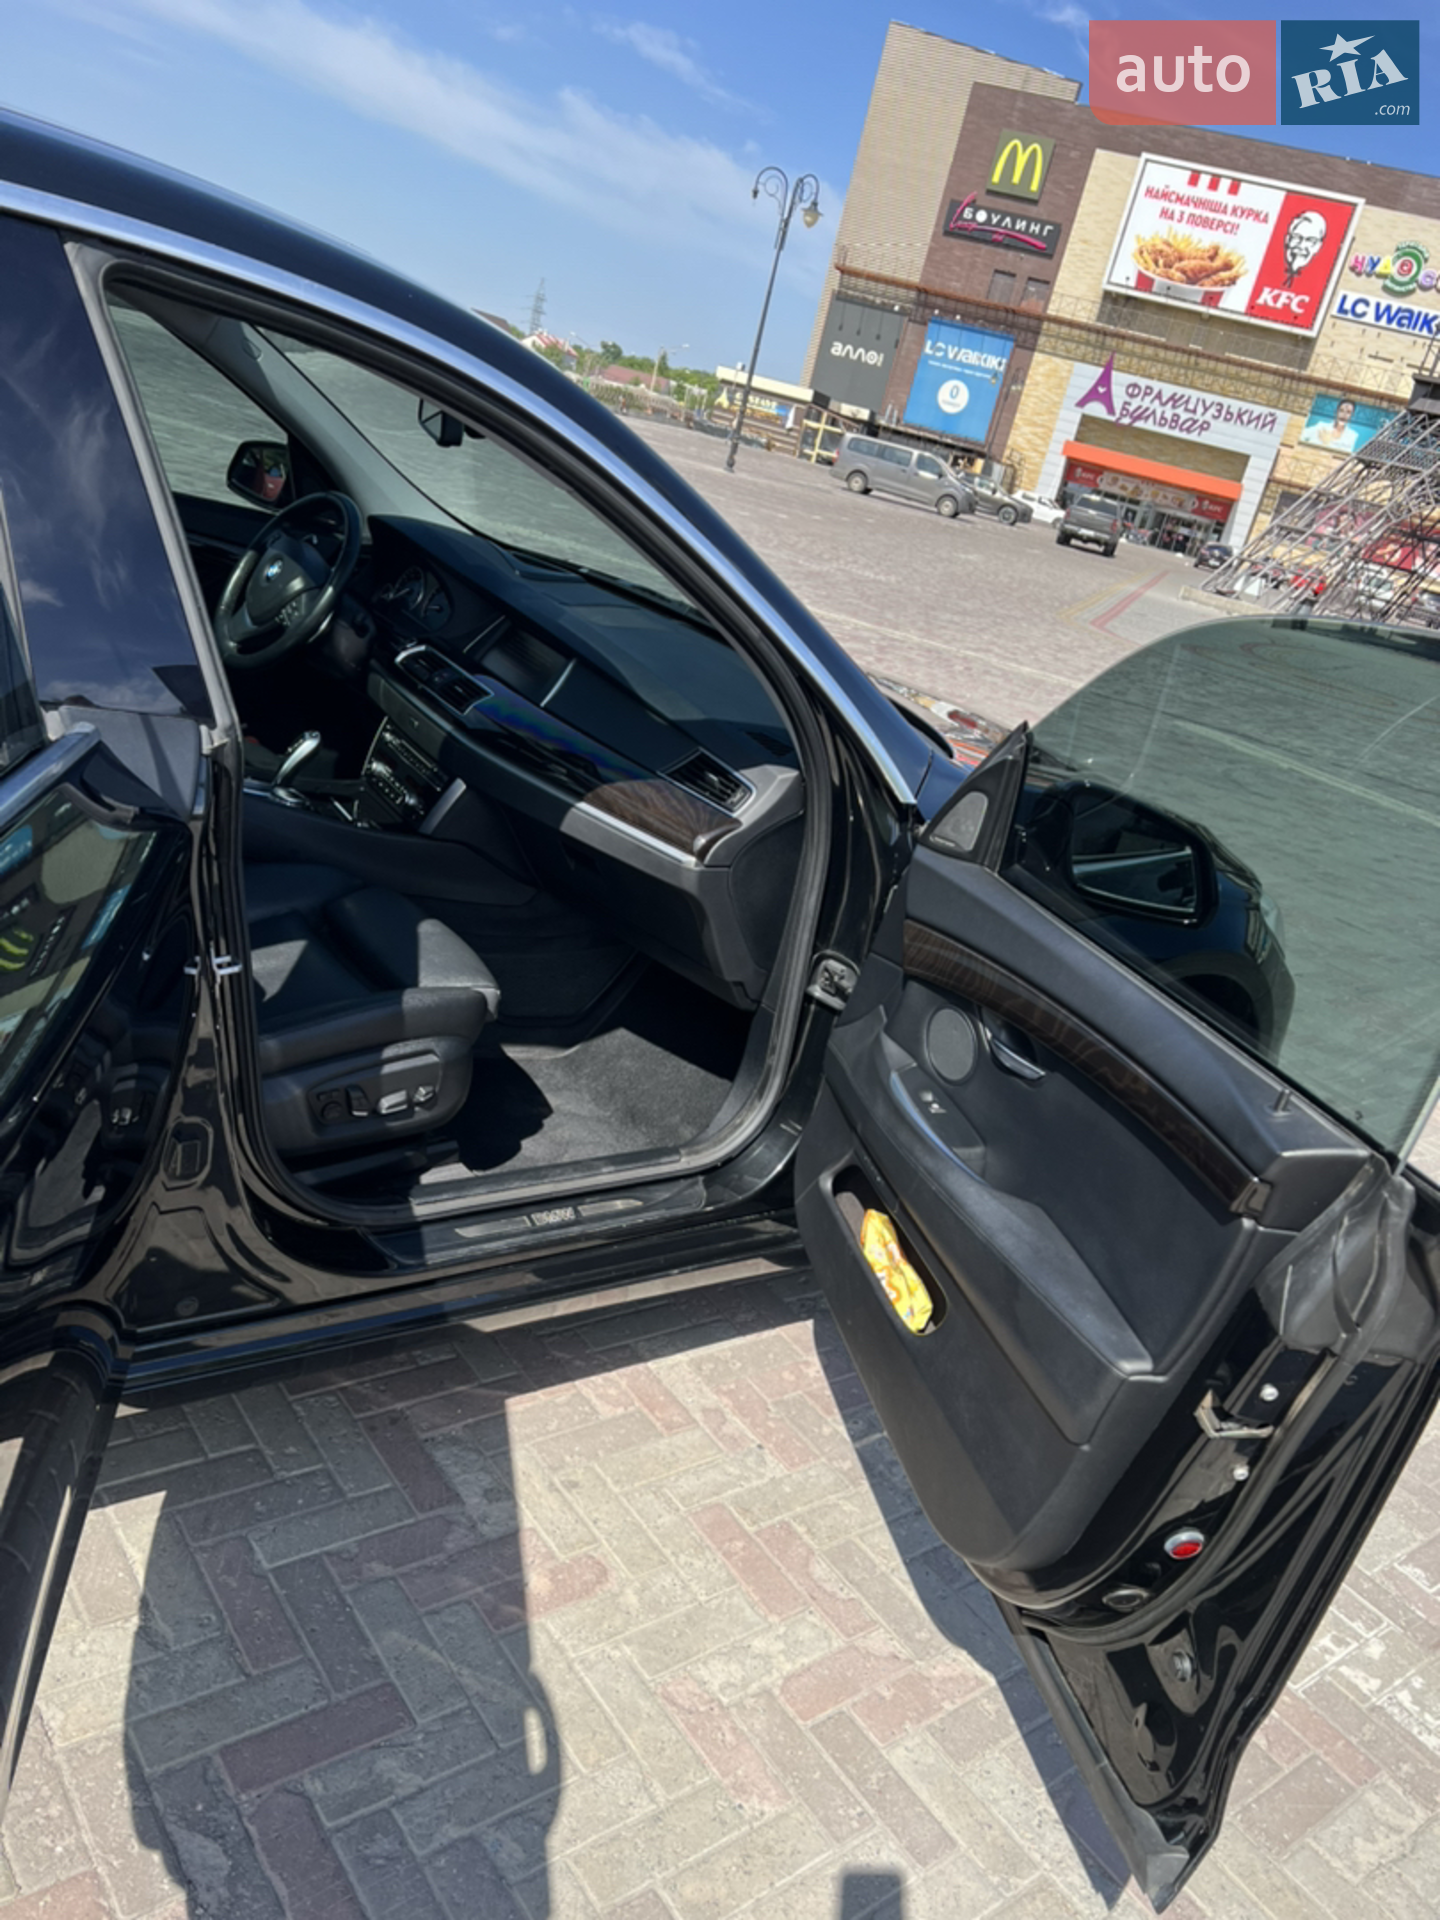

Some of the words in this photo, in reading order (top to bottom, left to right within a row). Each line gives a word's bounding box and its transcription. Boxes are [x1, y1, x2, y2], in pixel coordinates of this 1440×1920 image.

[962, 206, 1054, 237] БОУЛИНГ
[1144, 184, 1228, 216] НАЙСМАЧНІША
[1230, 204, 1270, 225] КУРКА
[1159, 206, 1175, 221] НА
[1186, 212, 1240, 236] ПОВЕРСІ!
[1255, 285, 1310, 314] KFC
[1336, 293, 1371, 319] LC
[1374, 301, 1440, 335] Waik
[1125, 381, 1278, 434] ФРАНЦУЗЬКИЙ
